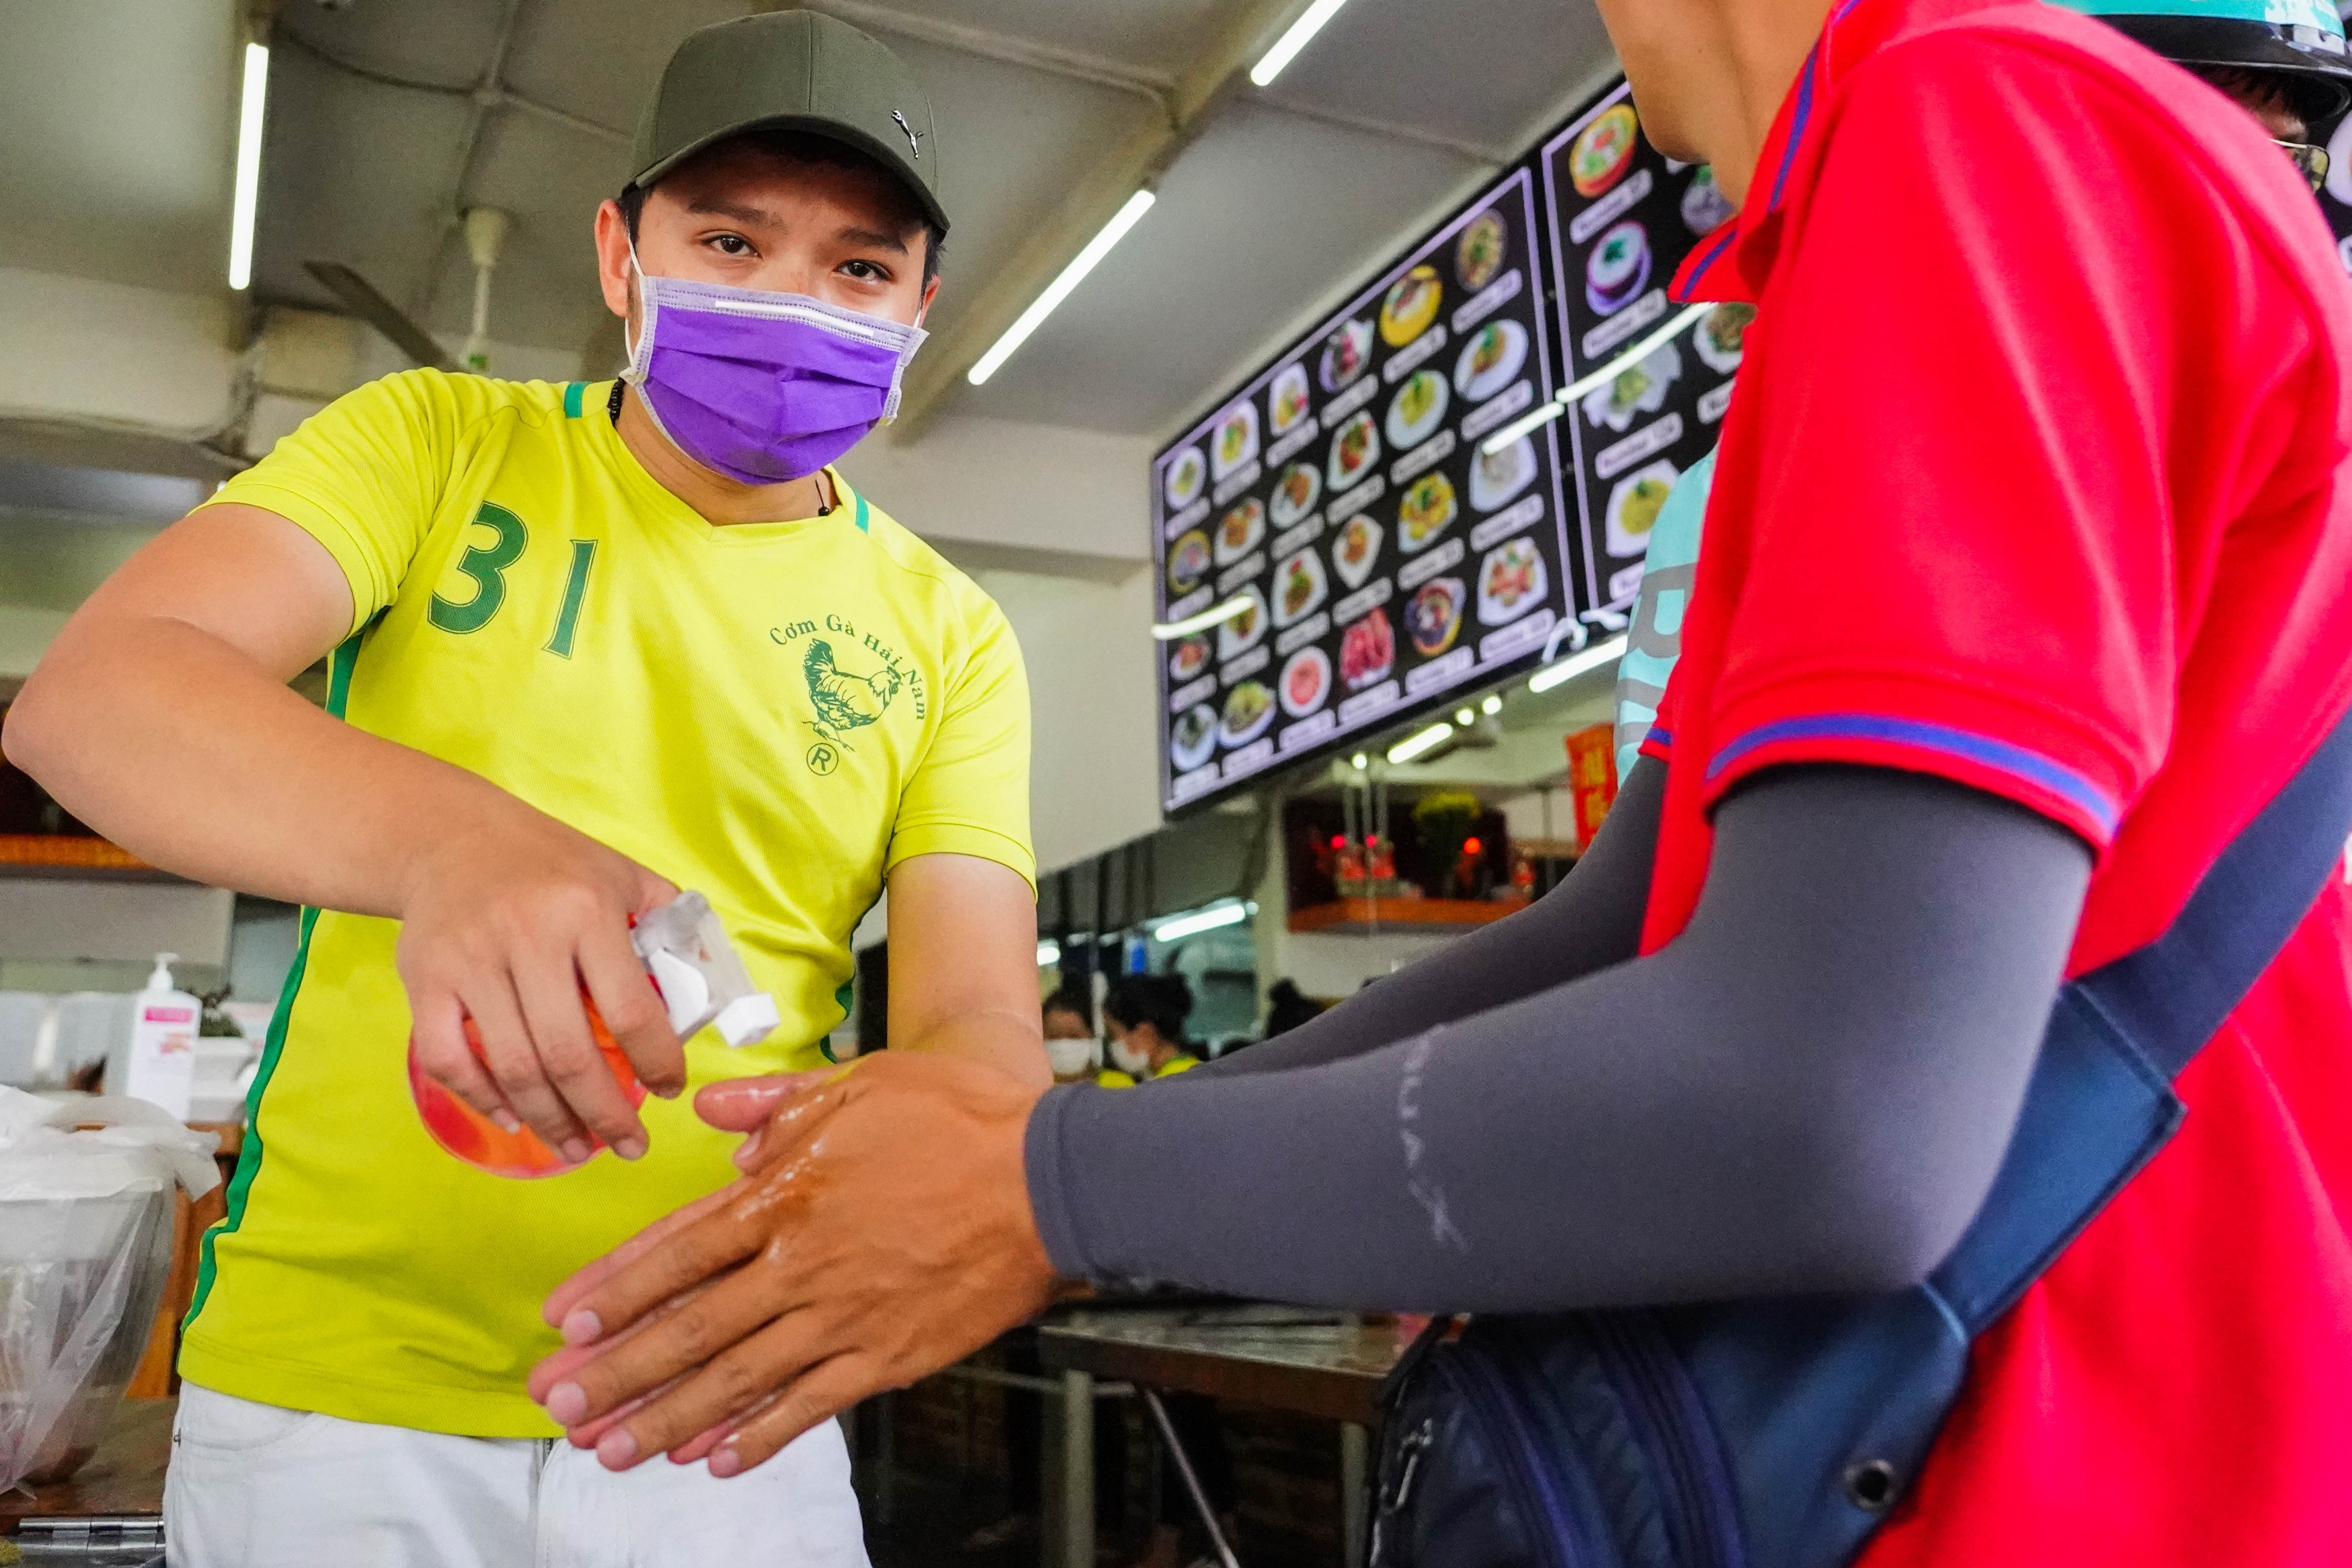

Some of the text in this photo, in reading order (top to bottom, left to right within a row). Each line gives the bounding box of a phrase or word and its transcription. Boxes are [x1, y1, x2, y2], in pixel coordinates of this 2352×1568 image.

[770, 614, 925, 720] Cơm Gà Hải Nam
